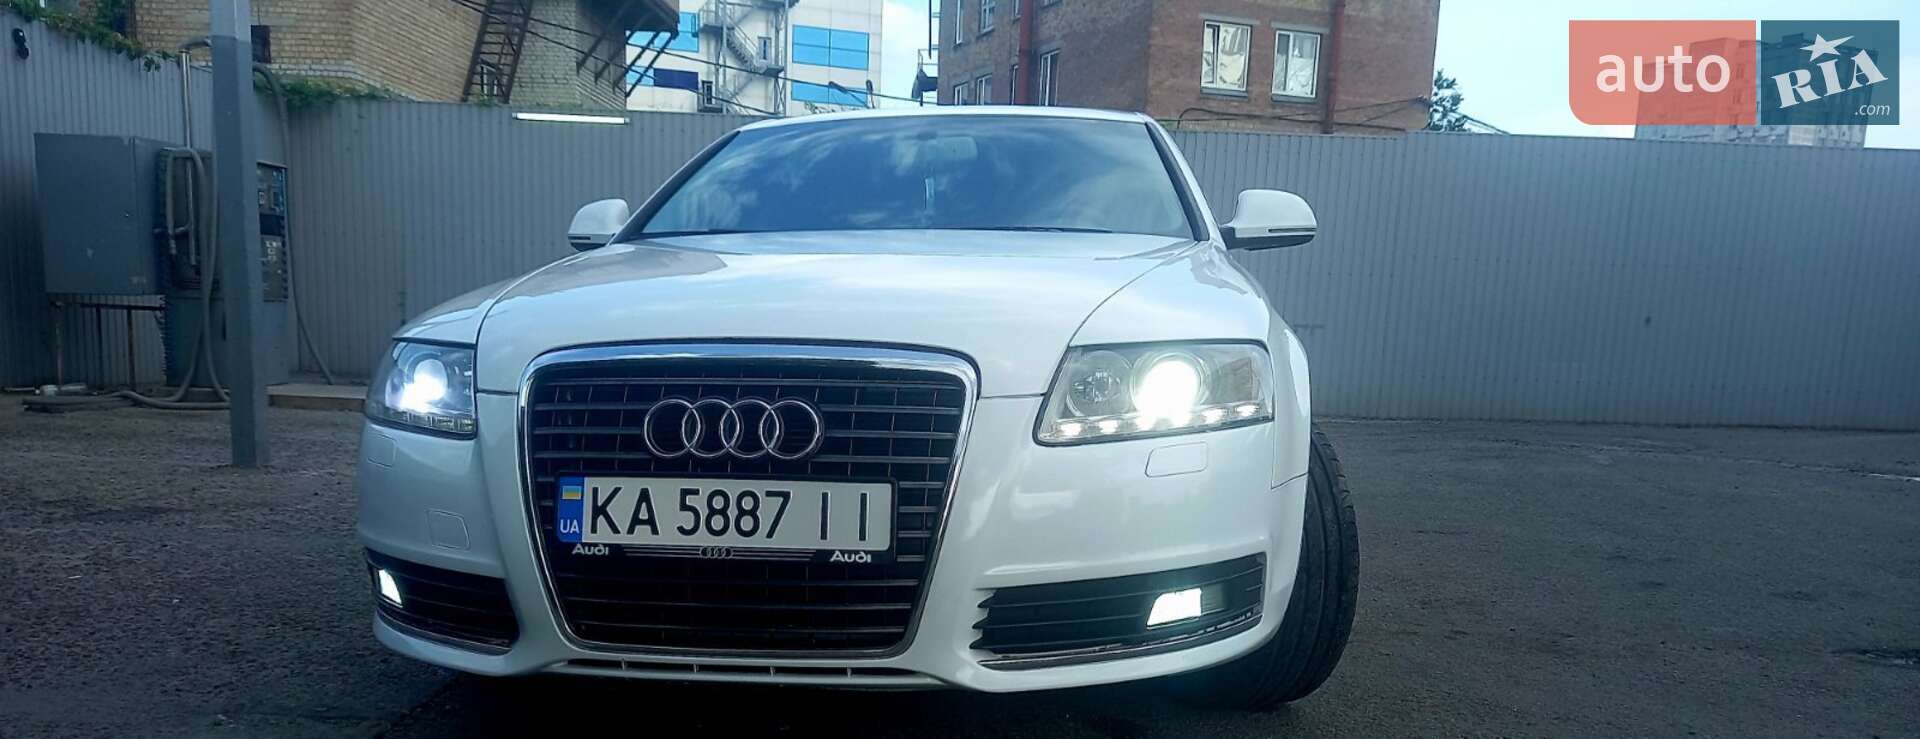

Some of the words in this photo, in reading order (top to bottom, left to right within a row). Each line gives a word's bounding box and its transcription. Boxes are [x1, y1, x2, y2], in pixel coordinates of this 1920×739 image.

[589, 486, 660, 536] KA
[676, 488, 792, 539] 5887
[559, 519, 580, 534] UA
[571, 543, 610, 556] Audi
[829, 549, 872, 563] Audi
